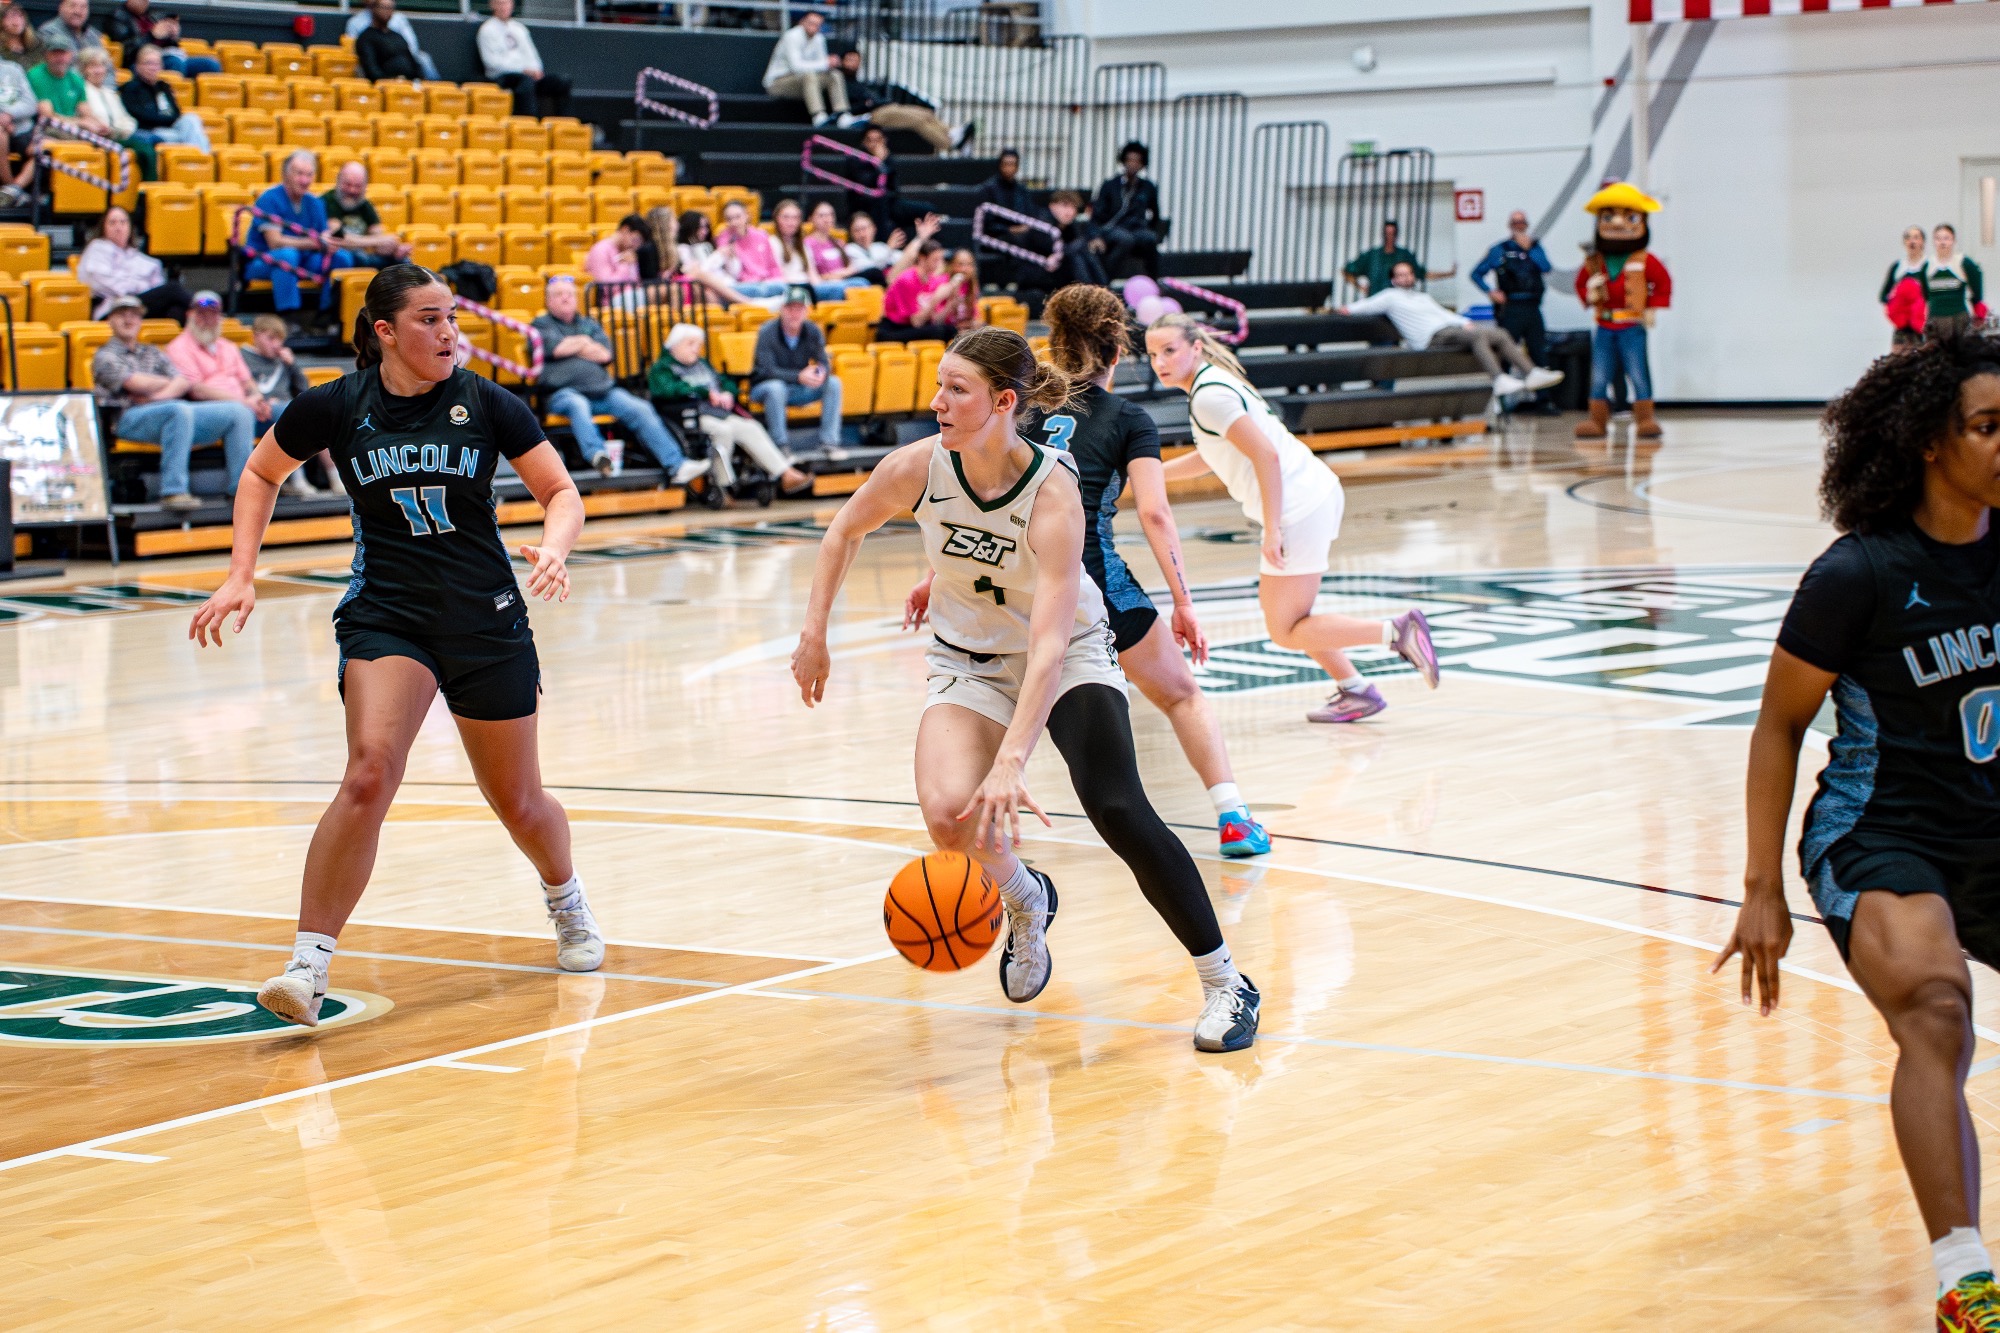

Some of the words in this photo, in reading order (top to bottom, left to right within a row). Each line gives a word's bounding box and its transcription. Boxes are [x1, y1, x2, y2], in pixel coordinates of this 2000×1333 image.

[1042, 414, 1077, 451] 3
[351, 444, 479, 486] LINCOLN
[390, 486, 456, 536] 11
[945, 524, 1014, 563] S&T
